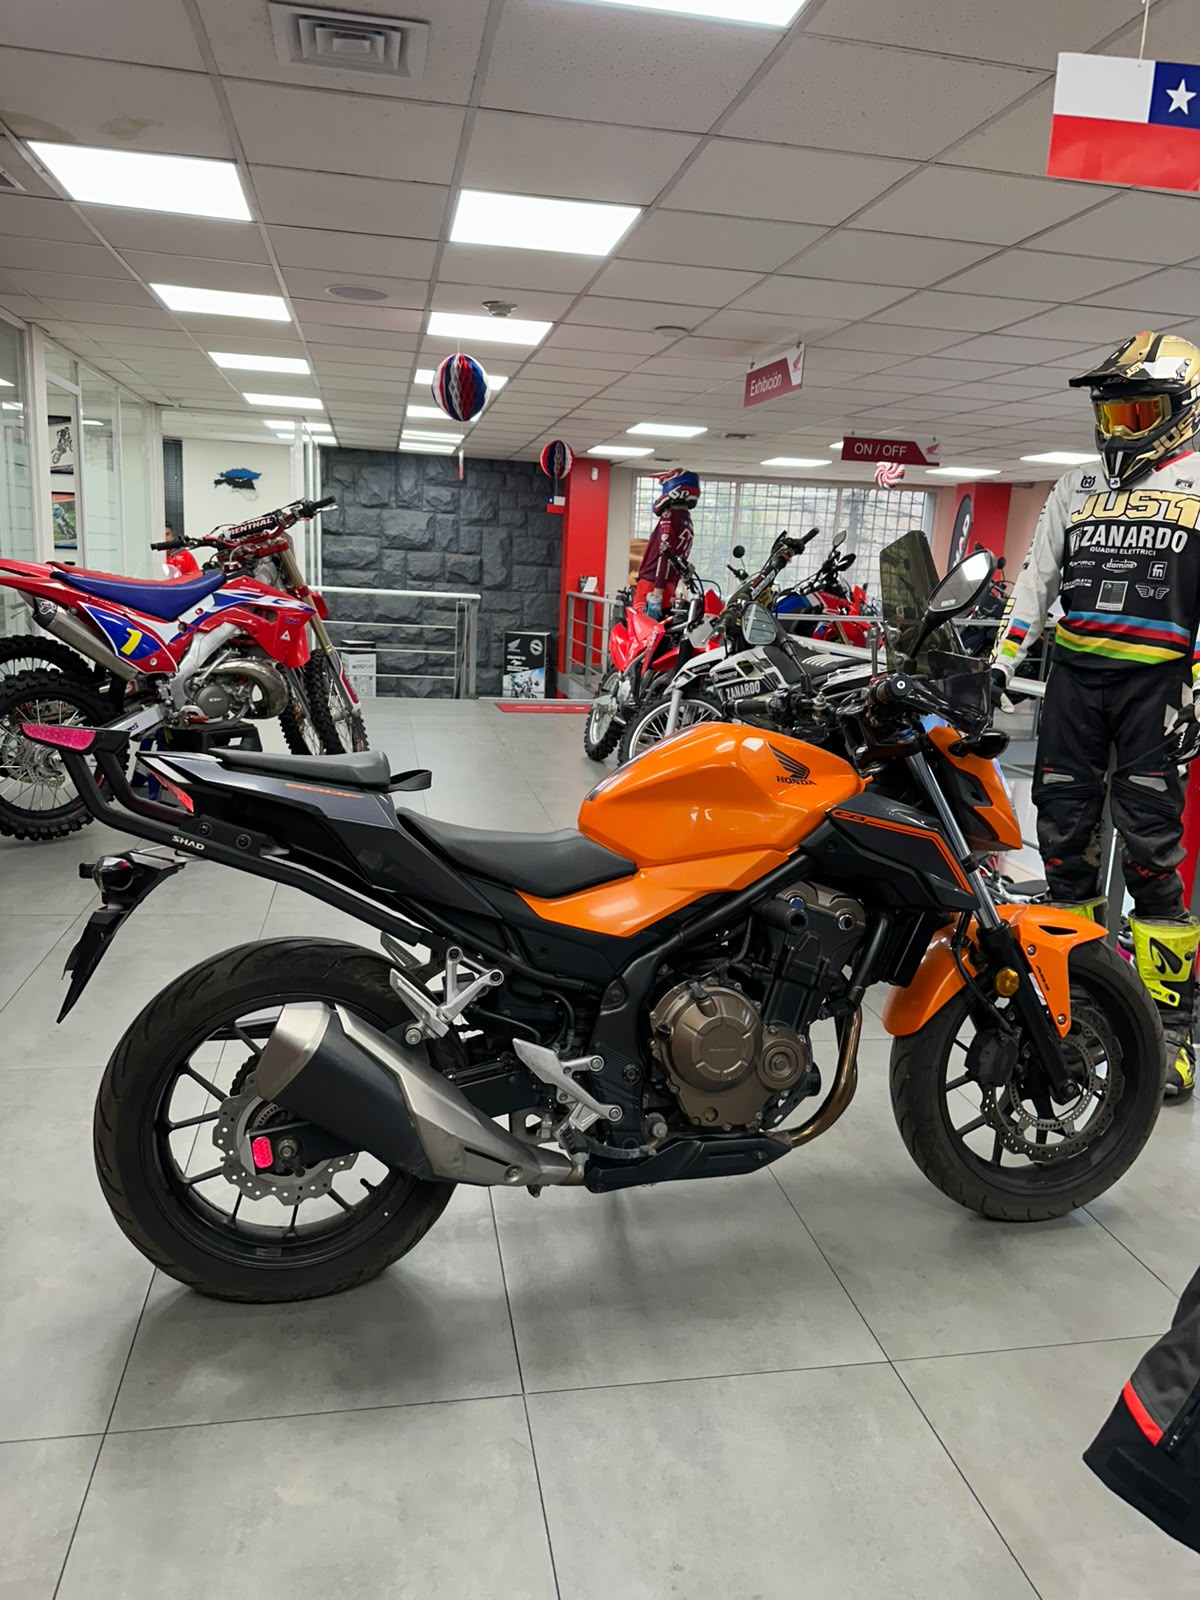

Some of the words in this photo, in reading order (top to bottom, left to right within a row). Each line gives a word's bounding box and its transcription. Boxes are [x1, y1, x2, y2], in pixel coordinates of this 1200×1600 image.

[749, 373, 783, 398] Exhibición
[853, 442, 873, 456] ON
[875, 444, 881, 457] /
[882, 444, 908, 458] OFF
[228, 517, 273, 536] RENTHAL
[1079, 525, 1188, 554] ZANARDO
[1089, 546, 1118, 555] QUADRI
[1119, 547, 1157, 560] ELETTRICI
[120, 627, 143, 656] 1
[725, 680, 762, 700] ZANARDO
[776, 775, 817, 786] HONDA
[172, 834, 206, 851] SHAD
